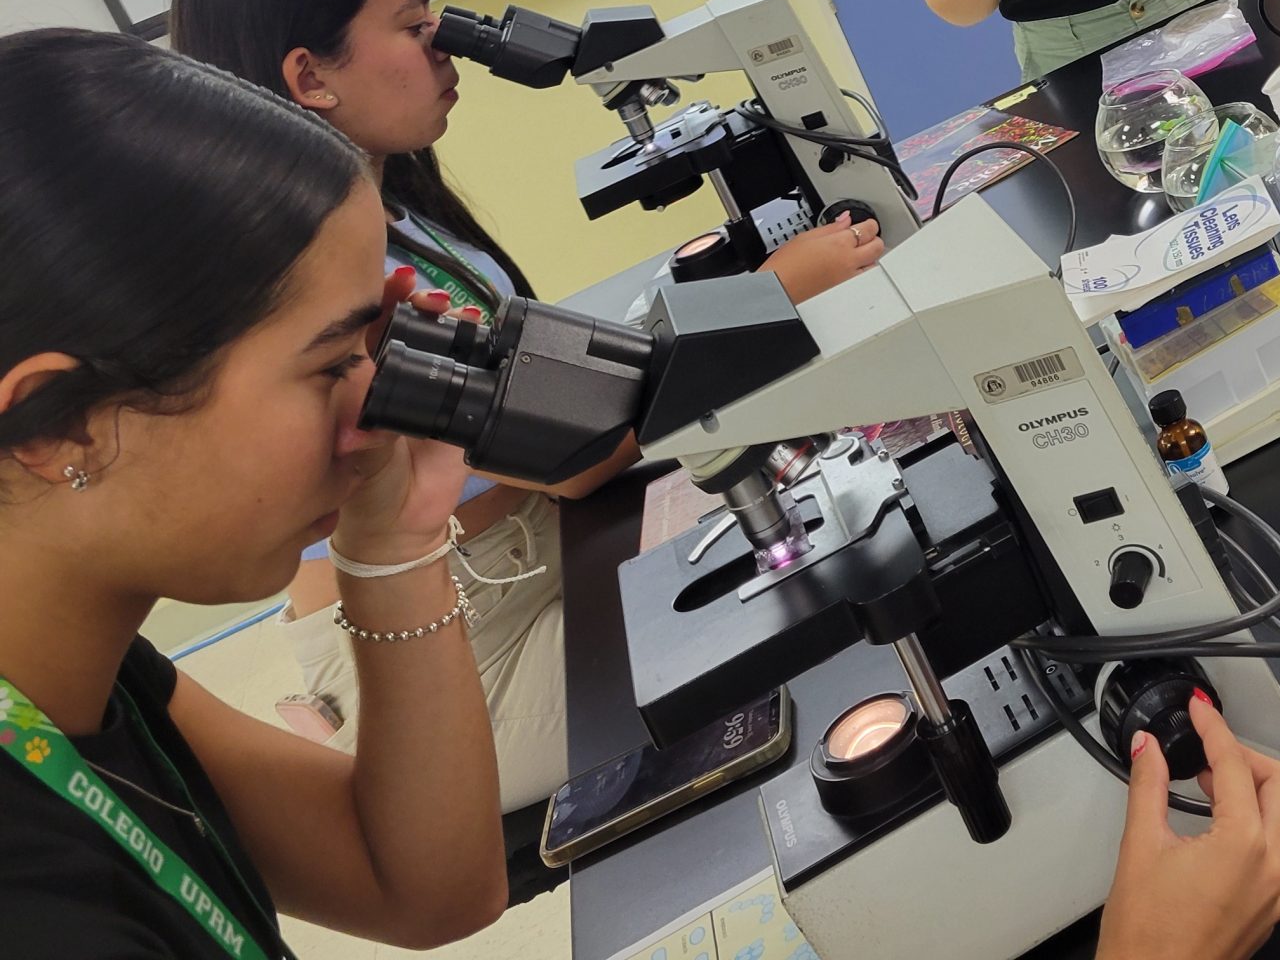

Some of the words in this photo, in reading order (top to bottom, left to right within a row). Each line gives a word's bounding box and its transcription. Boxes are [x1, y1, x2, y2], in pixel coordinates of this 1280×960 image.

[770, 66, 808, 82] OLYMPUS
[1200, 207, 1225, 251] Cleaning
[1221, 204, 1241, 232] Lens
[1182, 220, 1205, 260] Tissues
[1092, 276, 1109, 290] 100
[1018, 407, 1090, 432] OLYMPUS
[1032, 422, 1090, 450] CH30
[722, 712, 745, 750] 9:59
[776, 799, 798, 848] OLYMPUS
[67, 771, 165, 874] COLEGIO
[179, 873, 245, 956] UPRM
